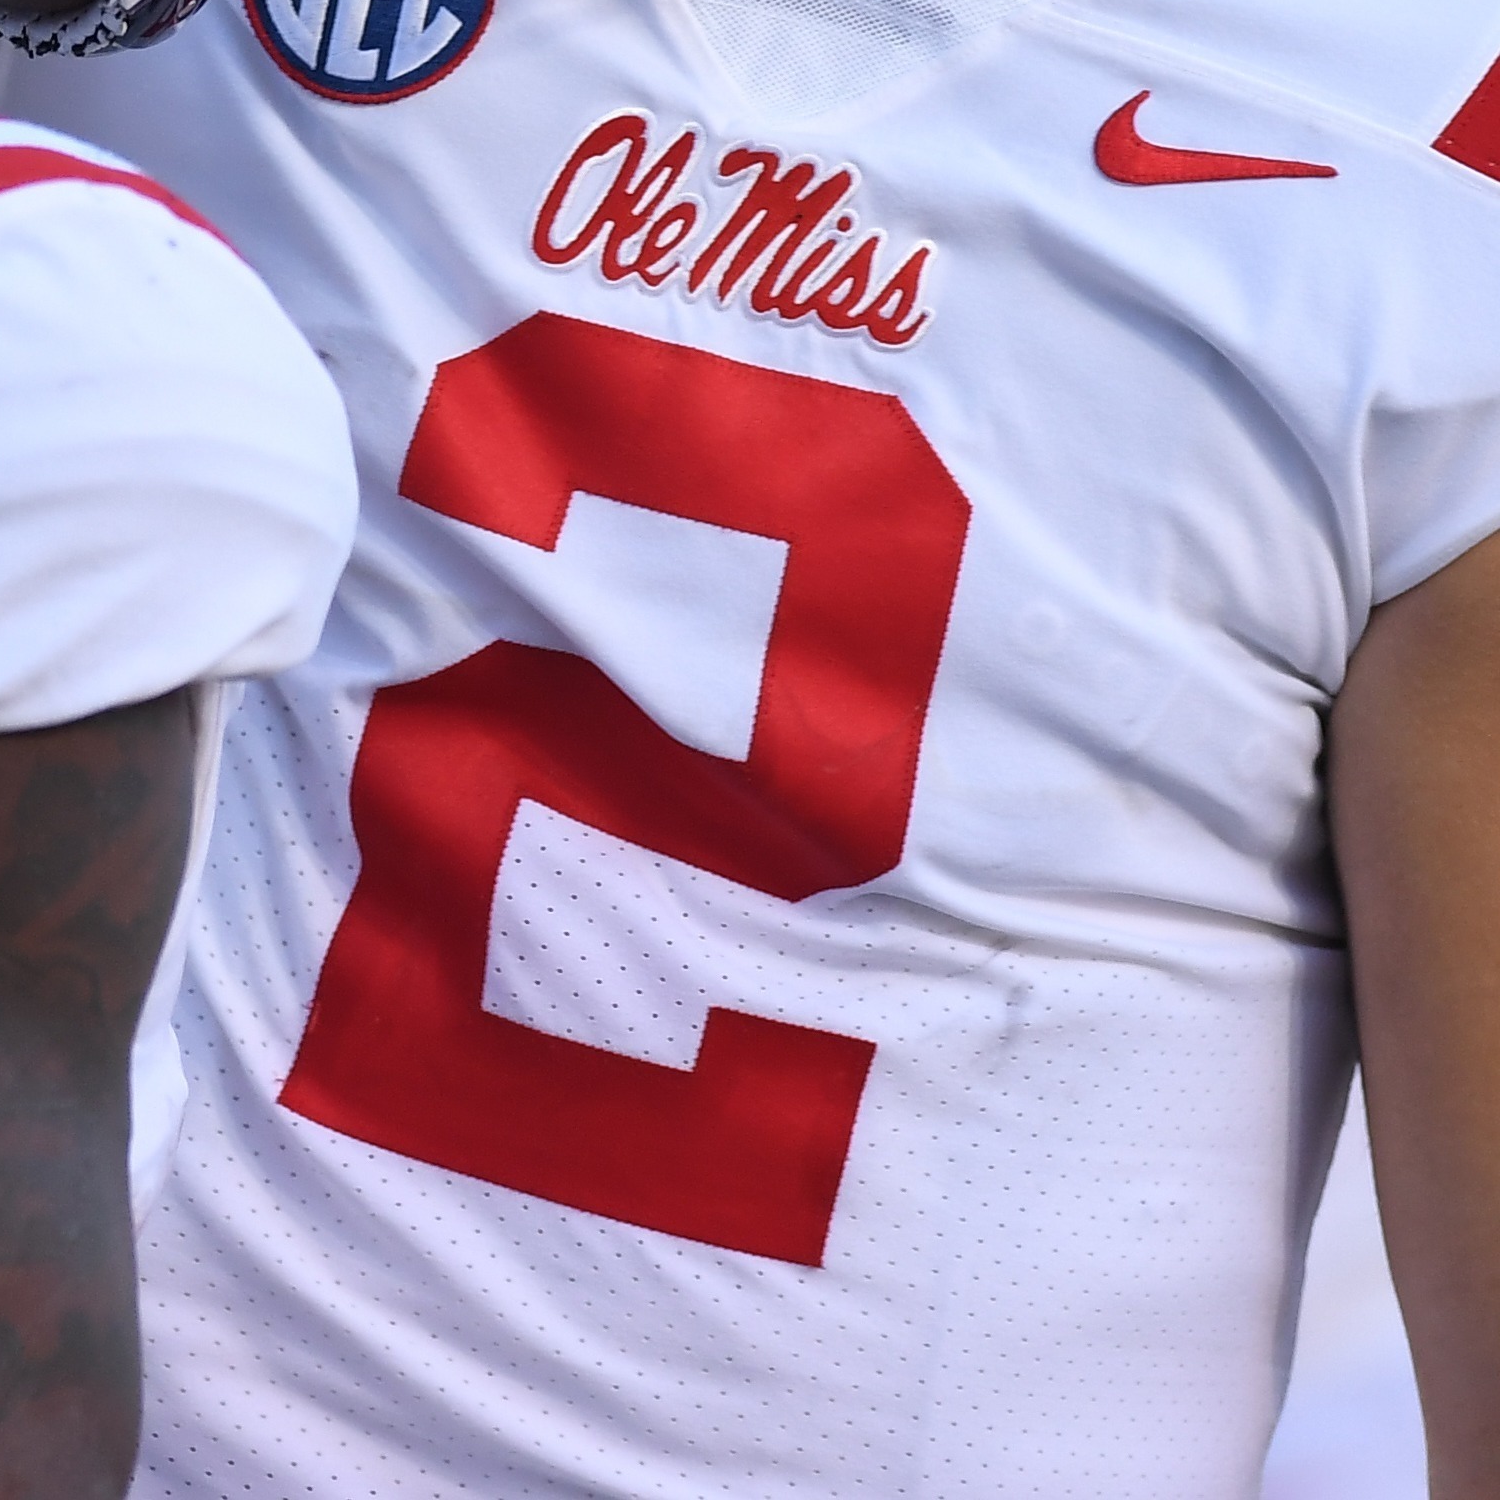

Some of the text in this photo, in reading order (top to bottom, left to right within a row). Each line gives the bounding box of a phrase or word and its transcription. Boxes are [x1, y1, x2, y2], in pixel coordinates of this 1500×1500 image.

[531, 109, 937, 349] Ole Miss
[277, 310, 972, 1268] 2
